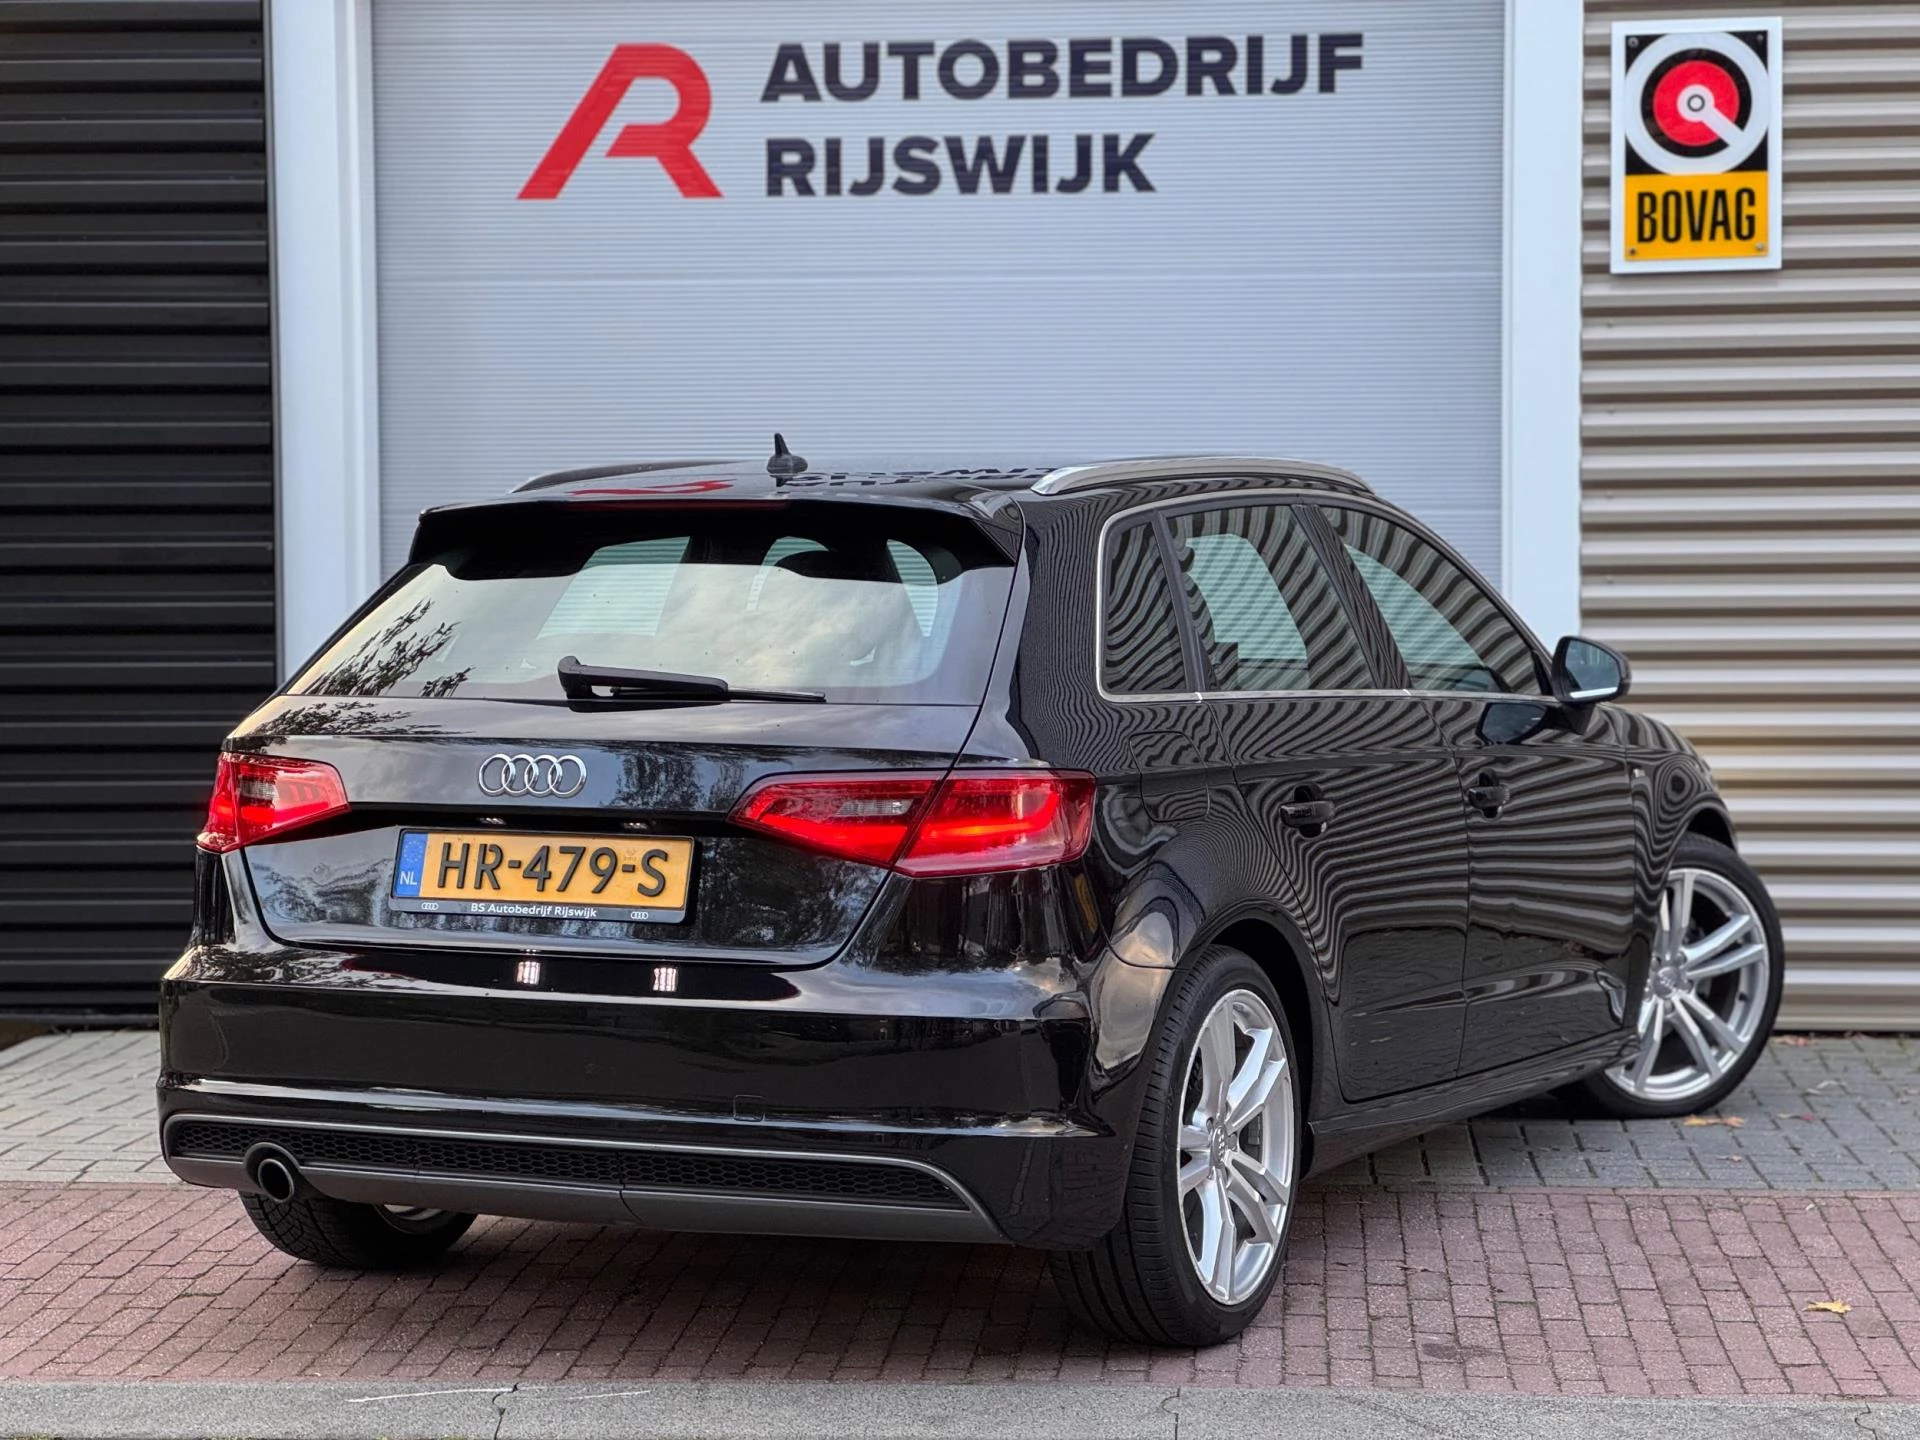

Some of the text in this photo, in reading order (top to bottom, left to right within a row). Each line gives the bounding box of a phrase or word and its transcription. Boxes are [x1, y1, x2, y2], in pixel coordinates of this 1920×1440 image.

[761, 33, 1364, 102] AUTOBEDRIJF
[765, 132, 1157, 197] RIJSWIJK
[1637, 187, 1756, 243] BOVAG
[399, 870, 418, 886] NL
[437, 841, 669, 898] HR-479-S
[470, 902, 597, 919] BS Autobedrijf Rijswijk
